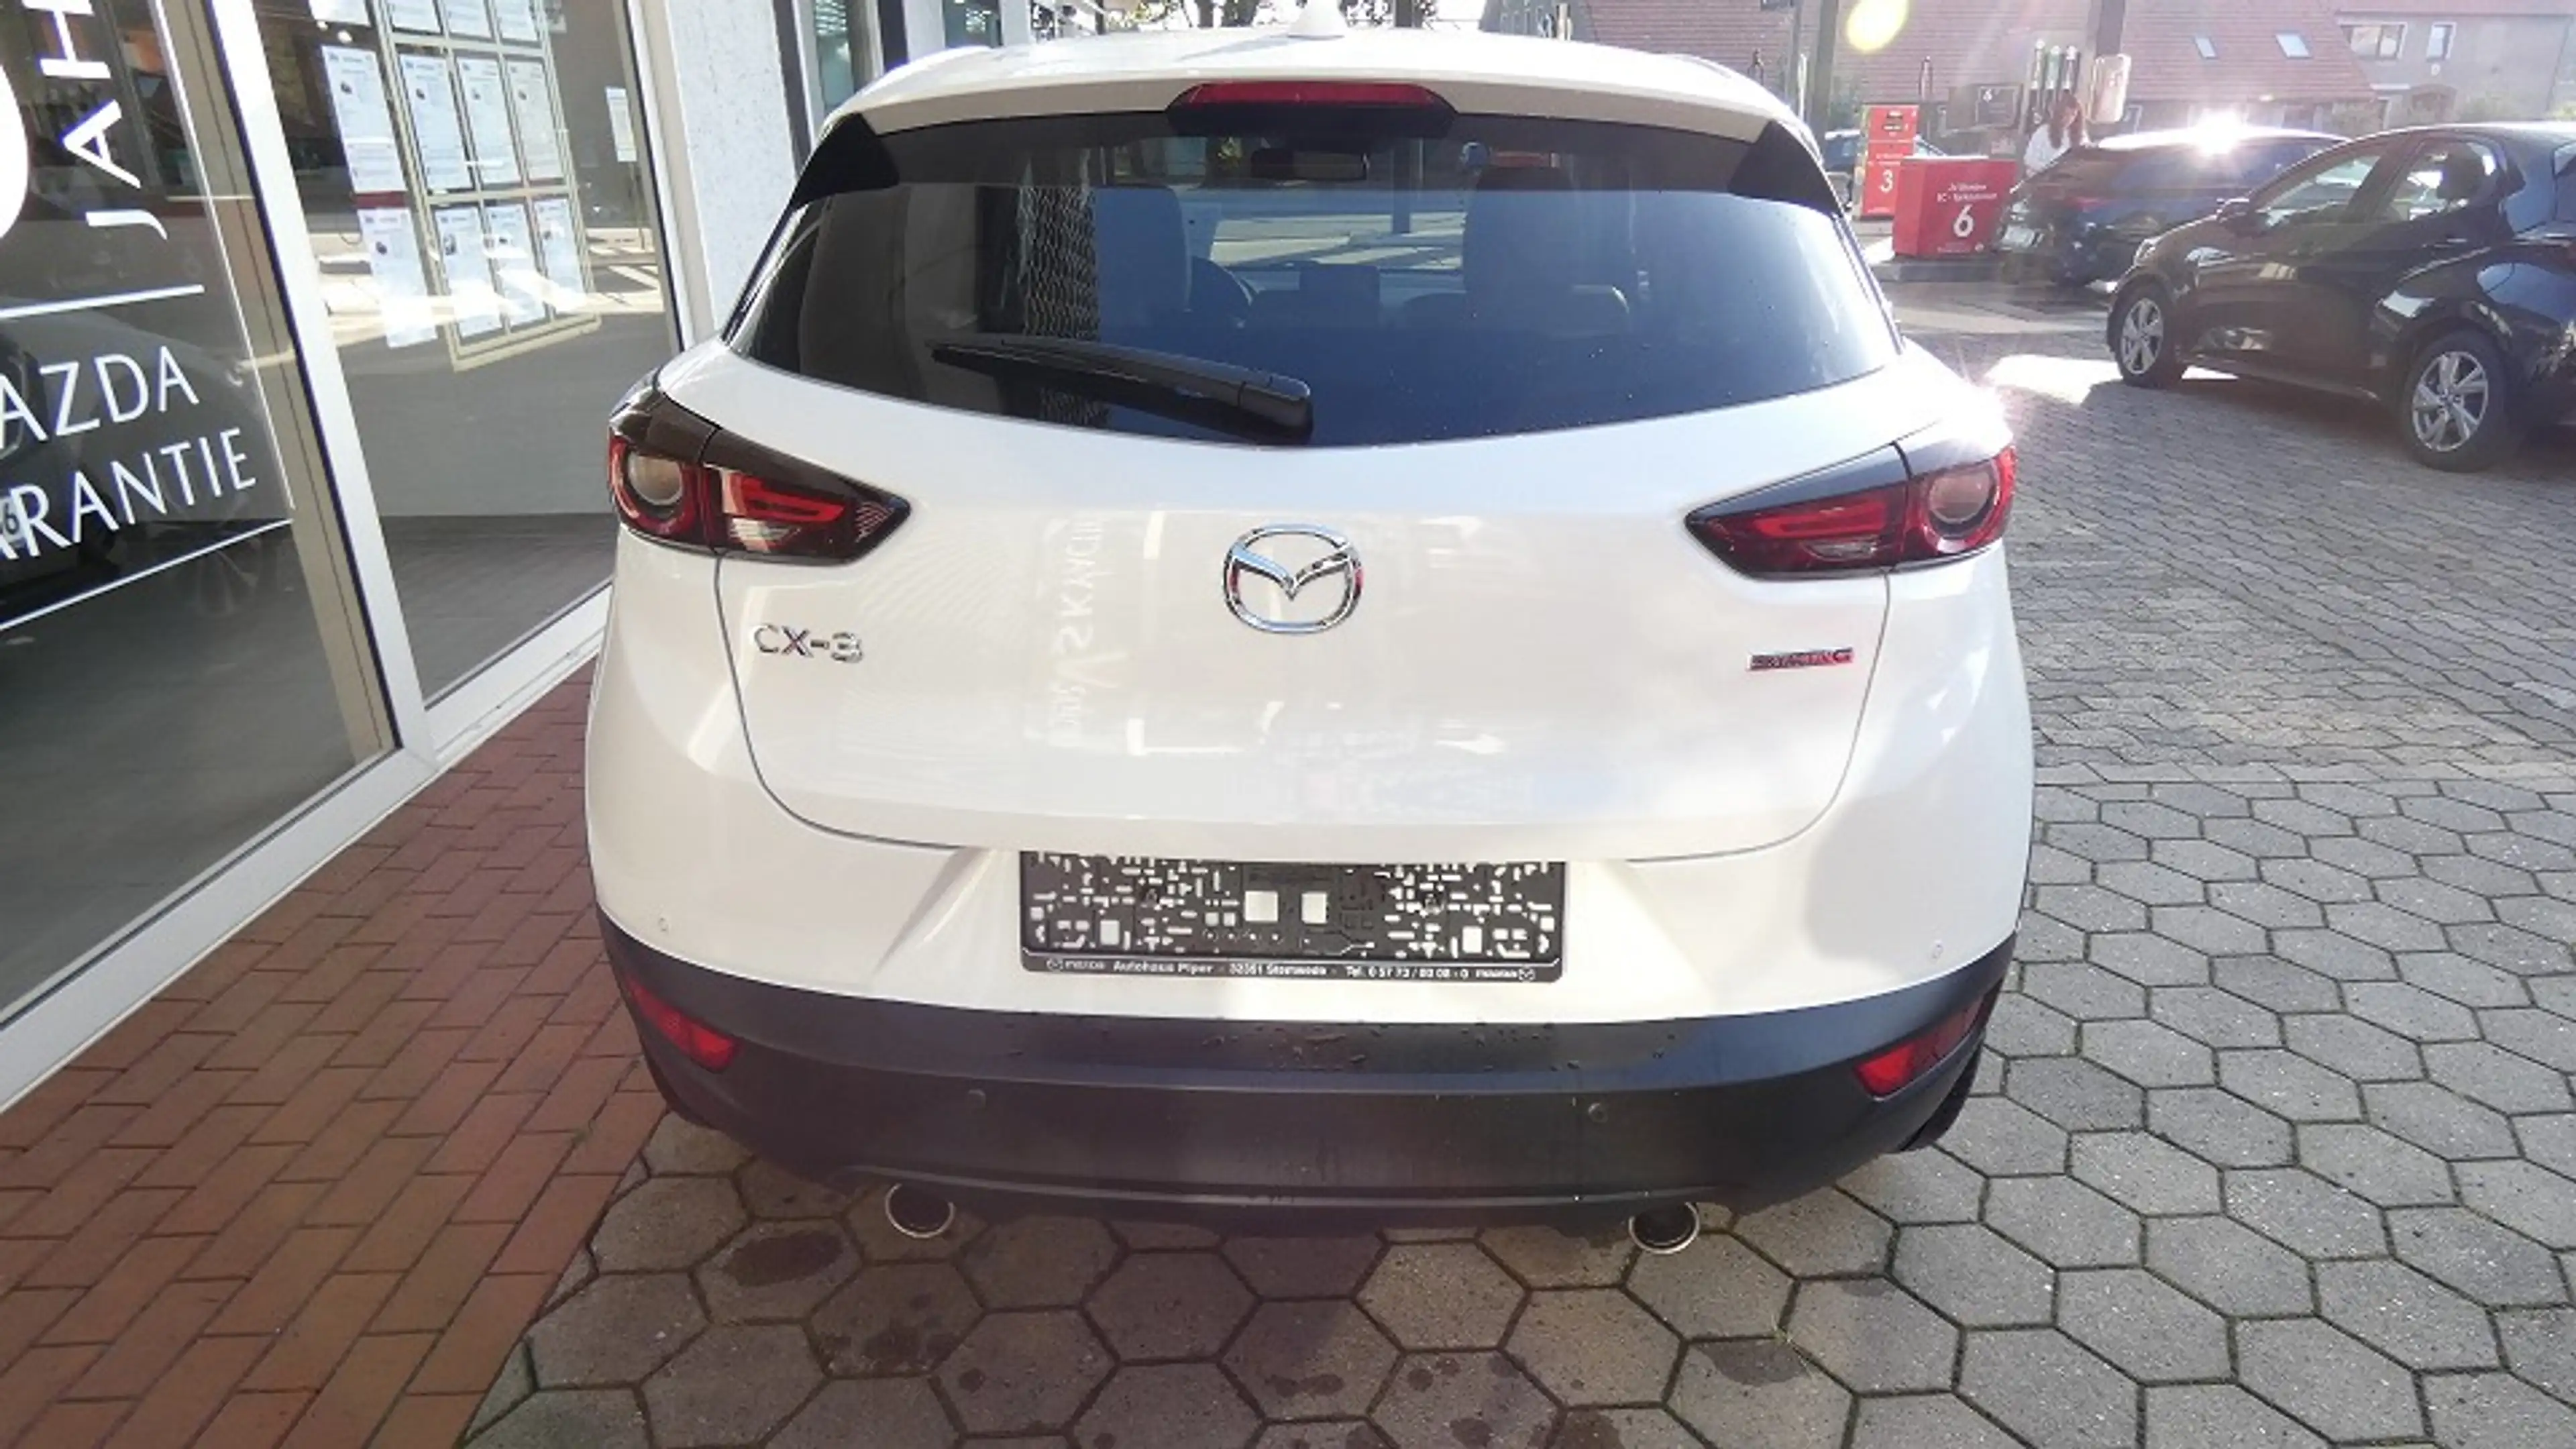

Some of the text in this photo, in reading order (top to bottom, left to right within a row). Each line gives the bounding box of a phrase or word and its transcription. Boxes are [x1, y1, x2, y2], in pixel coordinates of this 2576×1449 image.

[1880, 169, 1894, 193] 3
[1953, 204, 1974, 237] 6
[753, 623, 863, 663] CX-3
